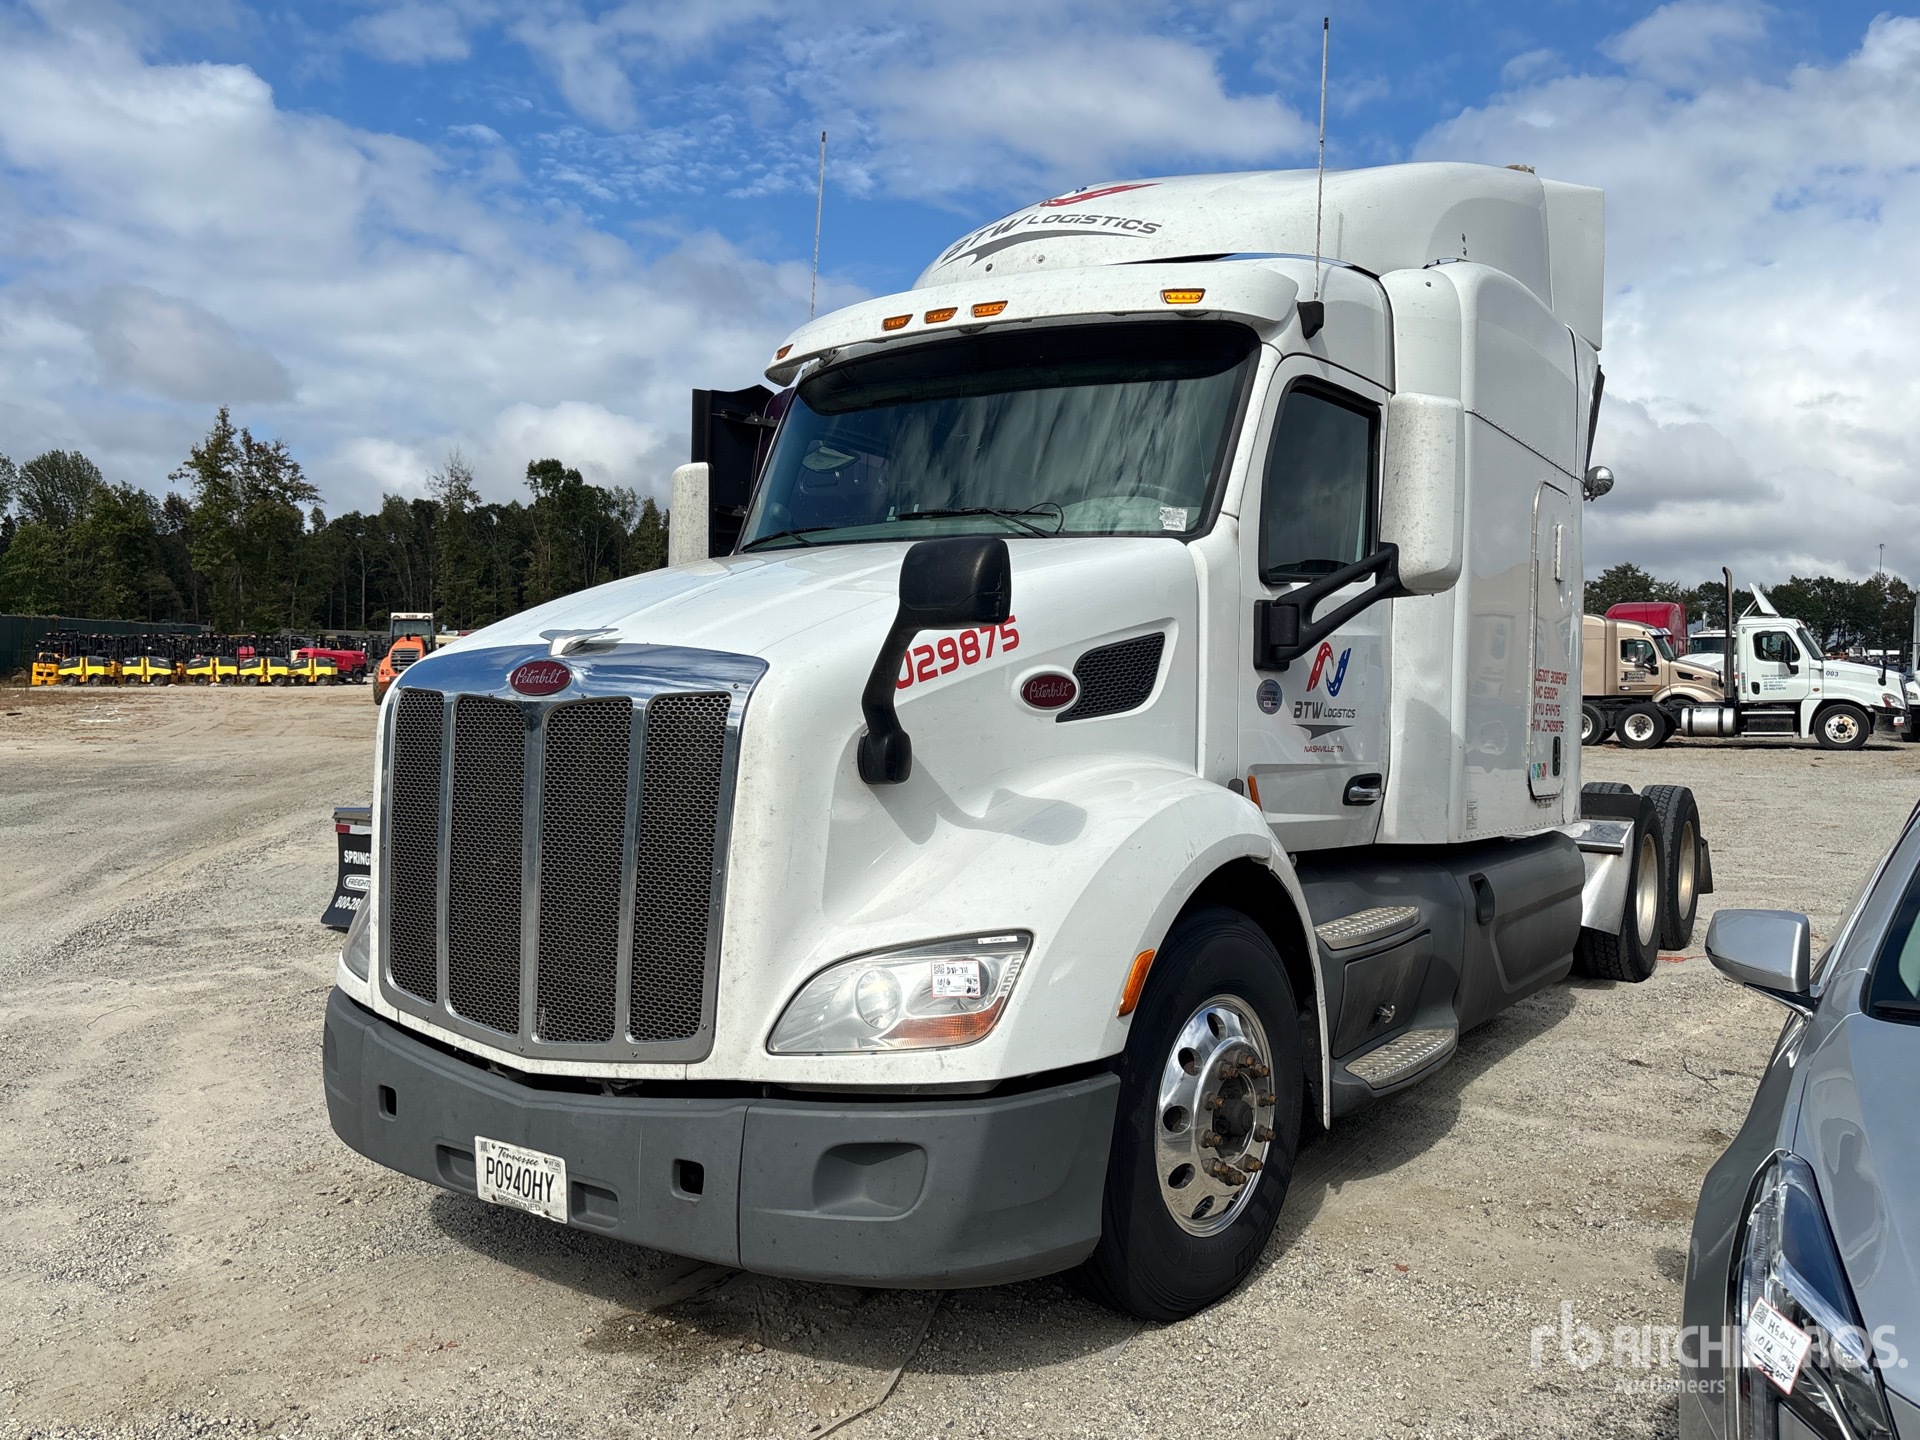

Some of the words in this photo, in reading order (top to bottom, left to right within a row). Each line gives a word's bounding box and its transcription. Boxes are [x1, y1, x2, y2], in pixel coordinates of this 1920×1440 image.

[941, 213, 1034, 264] BTW
[515, 667, 566, 685] Peterbilt
[1029, 680, 1071, 700] Peterbilt
[1293, 701, 1324, 719] BTW
[1336, 745, 1344, 753] TN
[343, 850, 372, 866] SPRING
[335, 895, 361, 910] 800-28
[498, 1146, 539, 1166] Tennessee
[486, 1156, 555, 1202] P0940HY
